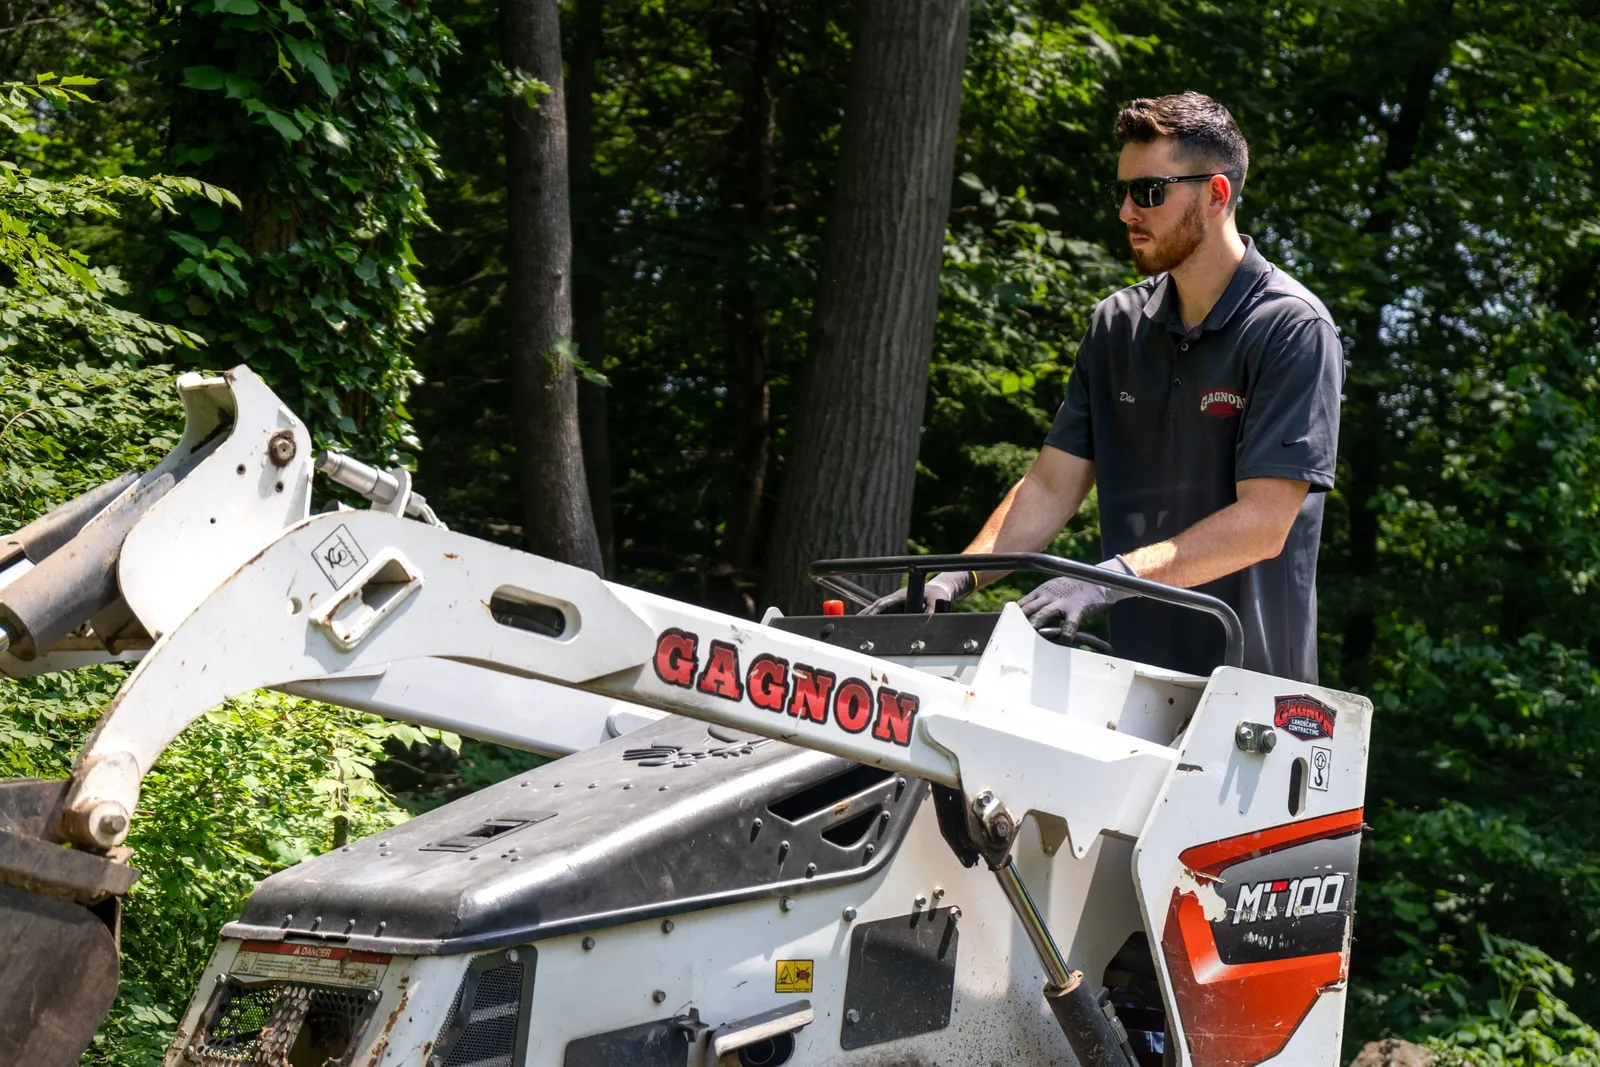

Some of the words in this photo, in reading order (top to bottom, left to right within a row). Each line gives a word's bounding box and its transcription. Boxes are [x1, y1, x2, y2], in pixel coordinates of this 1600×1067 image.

[1200, 391, 1246, 411] GAGNON
[653, 626, 920, 747] GAGNON
[1274, 700, 1334, 738] GAGNON
[1291, 719, 1318, 729] LANDSCAPE
[1288, 725, 1320, 736] CONTRACTING
[301, 947, 332, 957] DANGER
